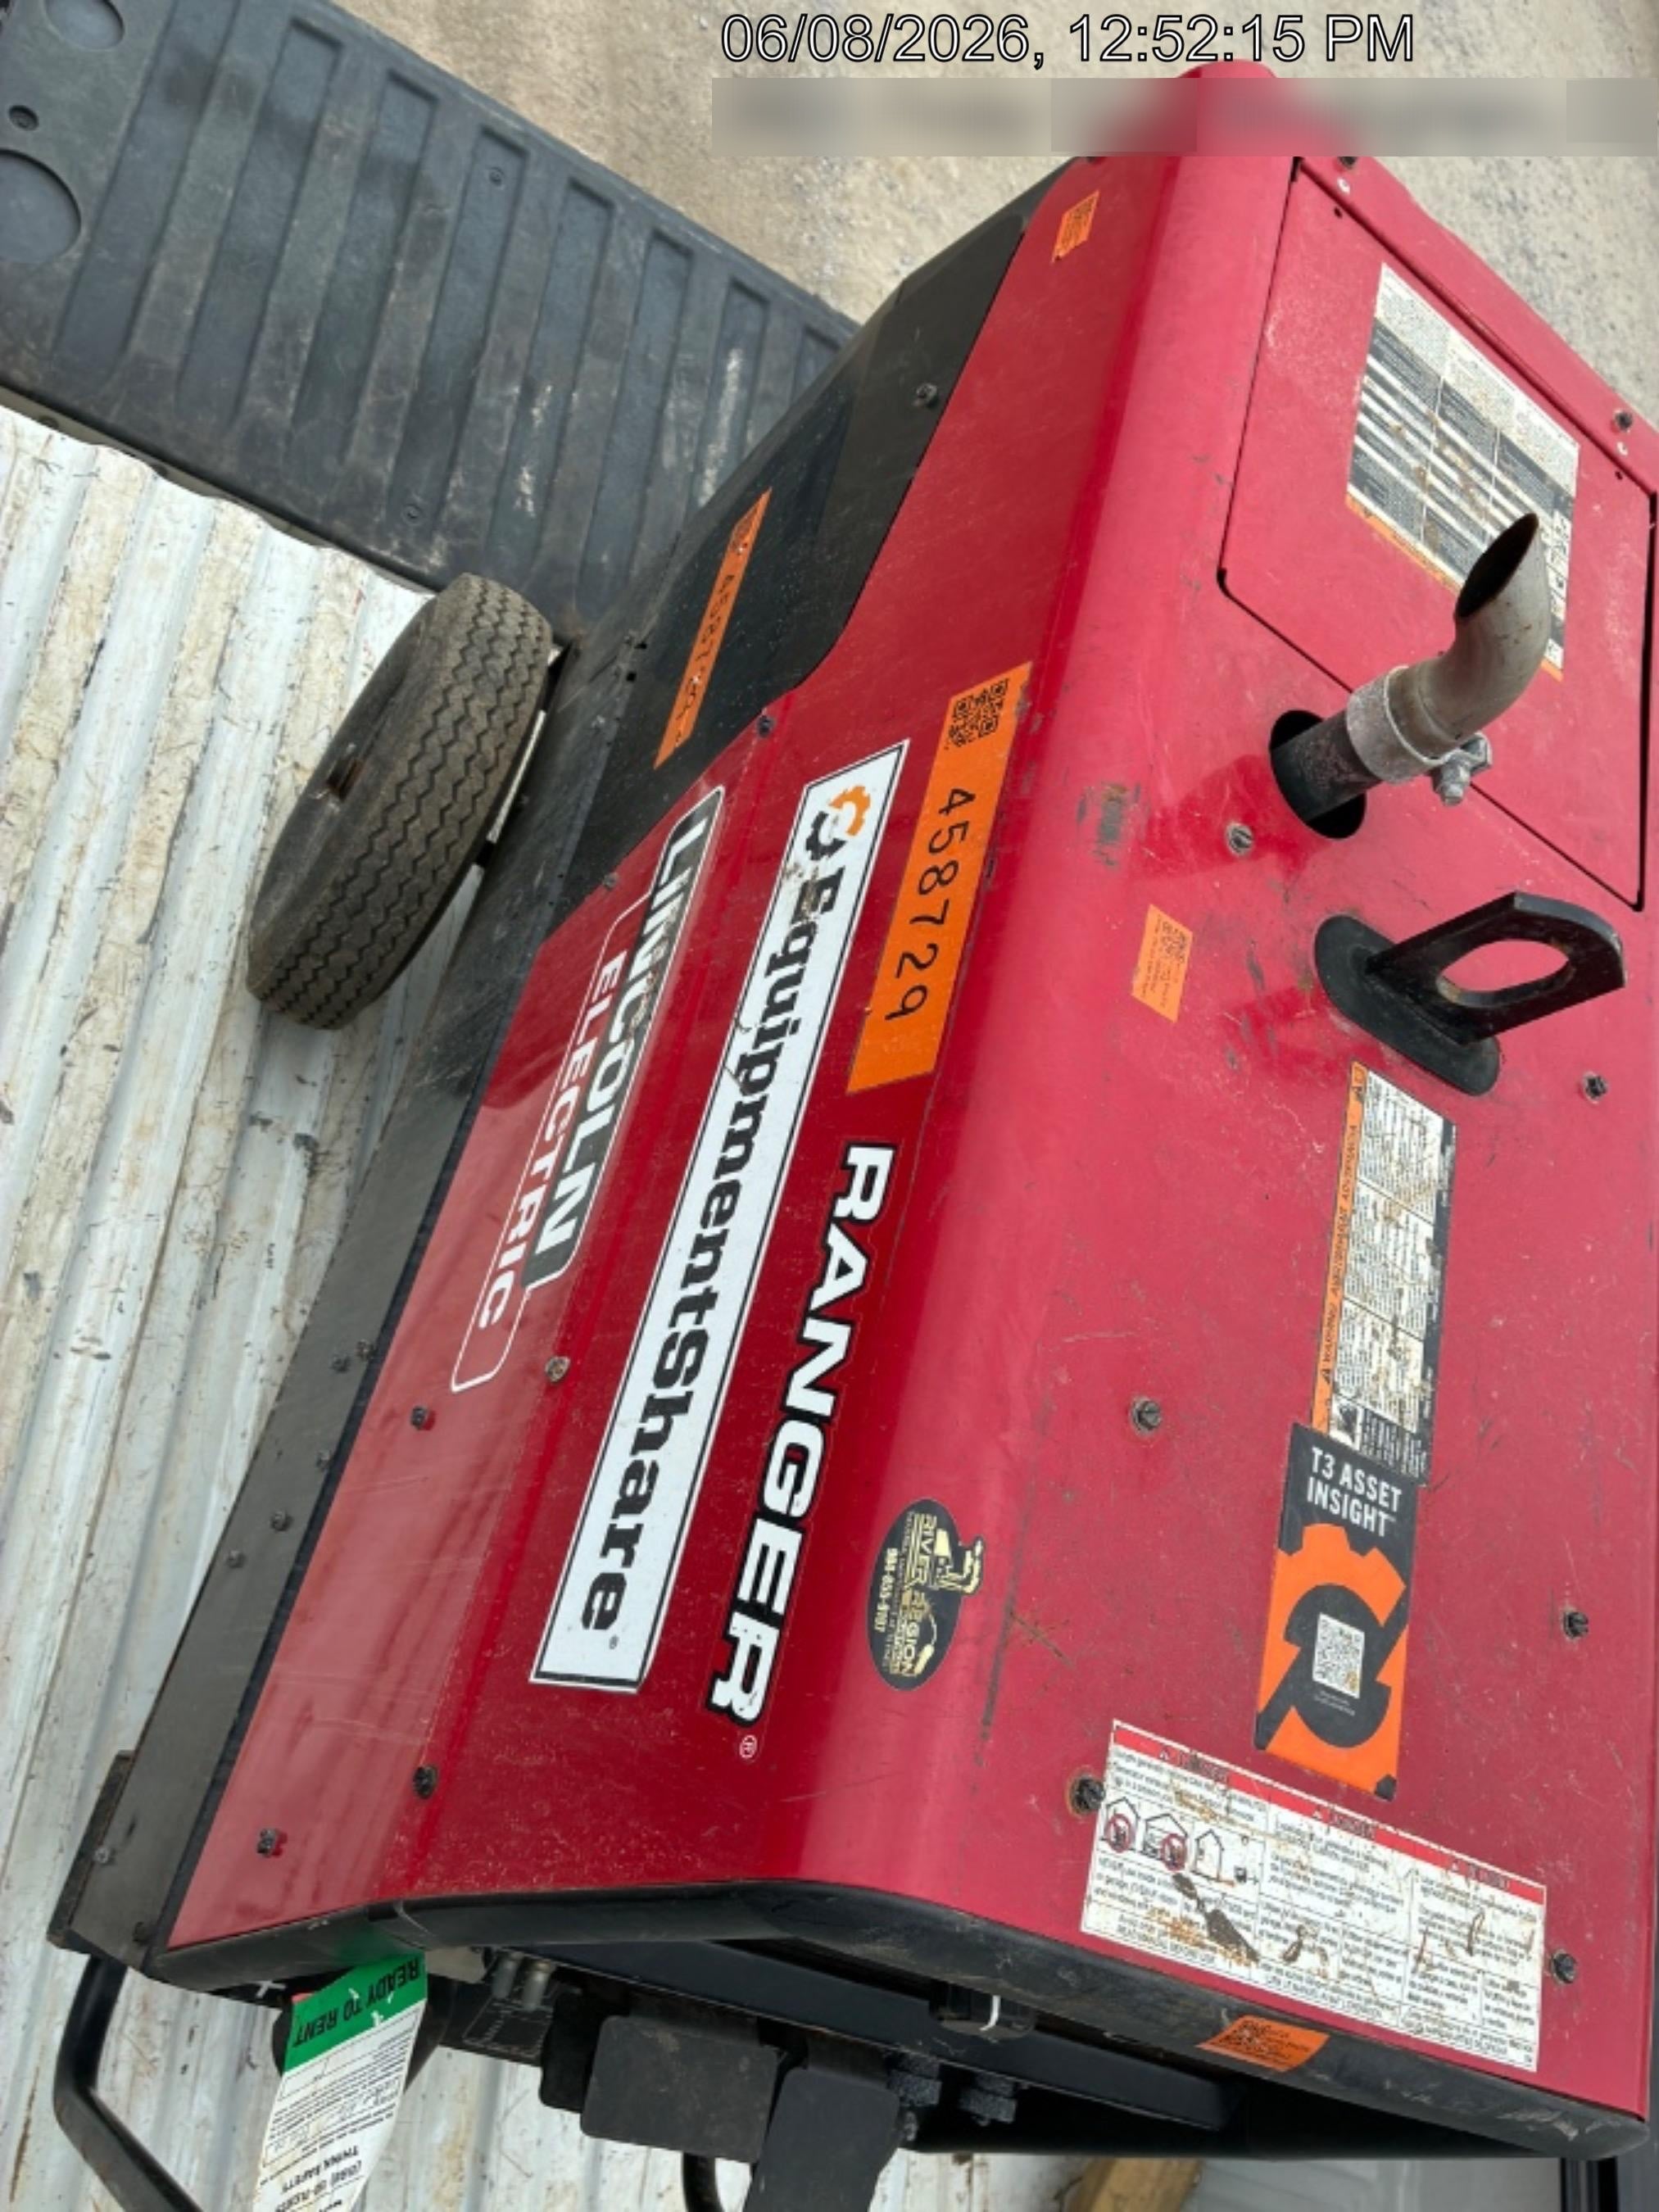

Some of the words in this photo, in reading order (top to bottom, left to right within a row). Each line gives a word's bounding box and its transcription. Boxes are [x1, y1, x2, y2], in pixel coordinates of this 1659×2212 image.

[885, 787, 976, 1022] 458729
[535, 818, 706, 1256] LINCOLN
[478, 952, 627, 1328] ELECTRIC
[580, 866, 844, 1631] EquipmentShare
[706, 1145, 896, 1725] RANGER
[1307, 1476, 1389, 1537] INSIGHT
[1312, 1447, 1335, 1480] T3
[1339, 1463, 1402, 1512] ASSET
[295, 2010, 338, 2047] RENT
[343, 1997, 362, 2021] TO
[366, 1957, 419, 2007] READY
